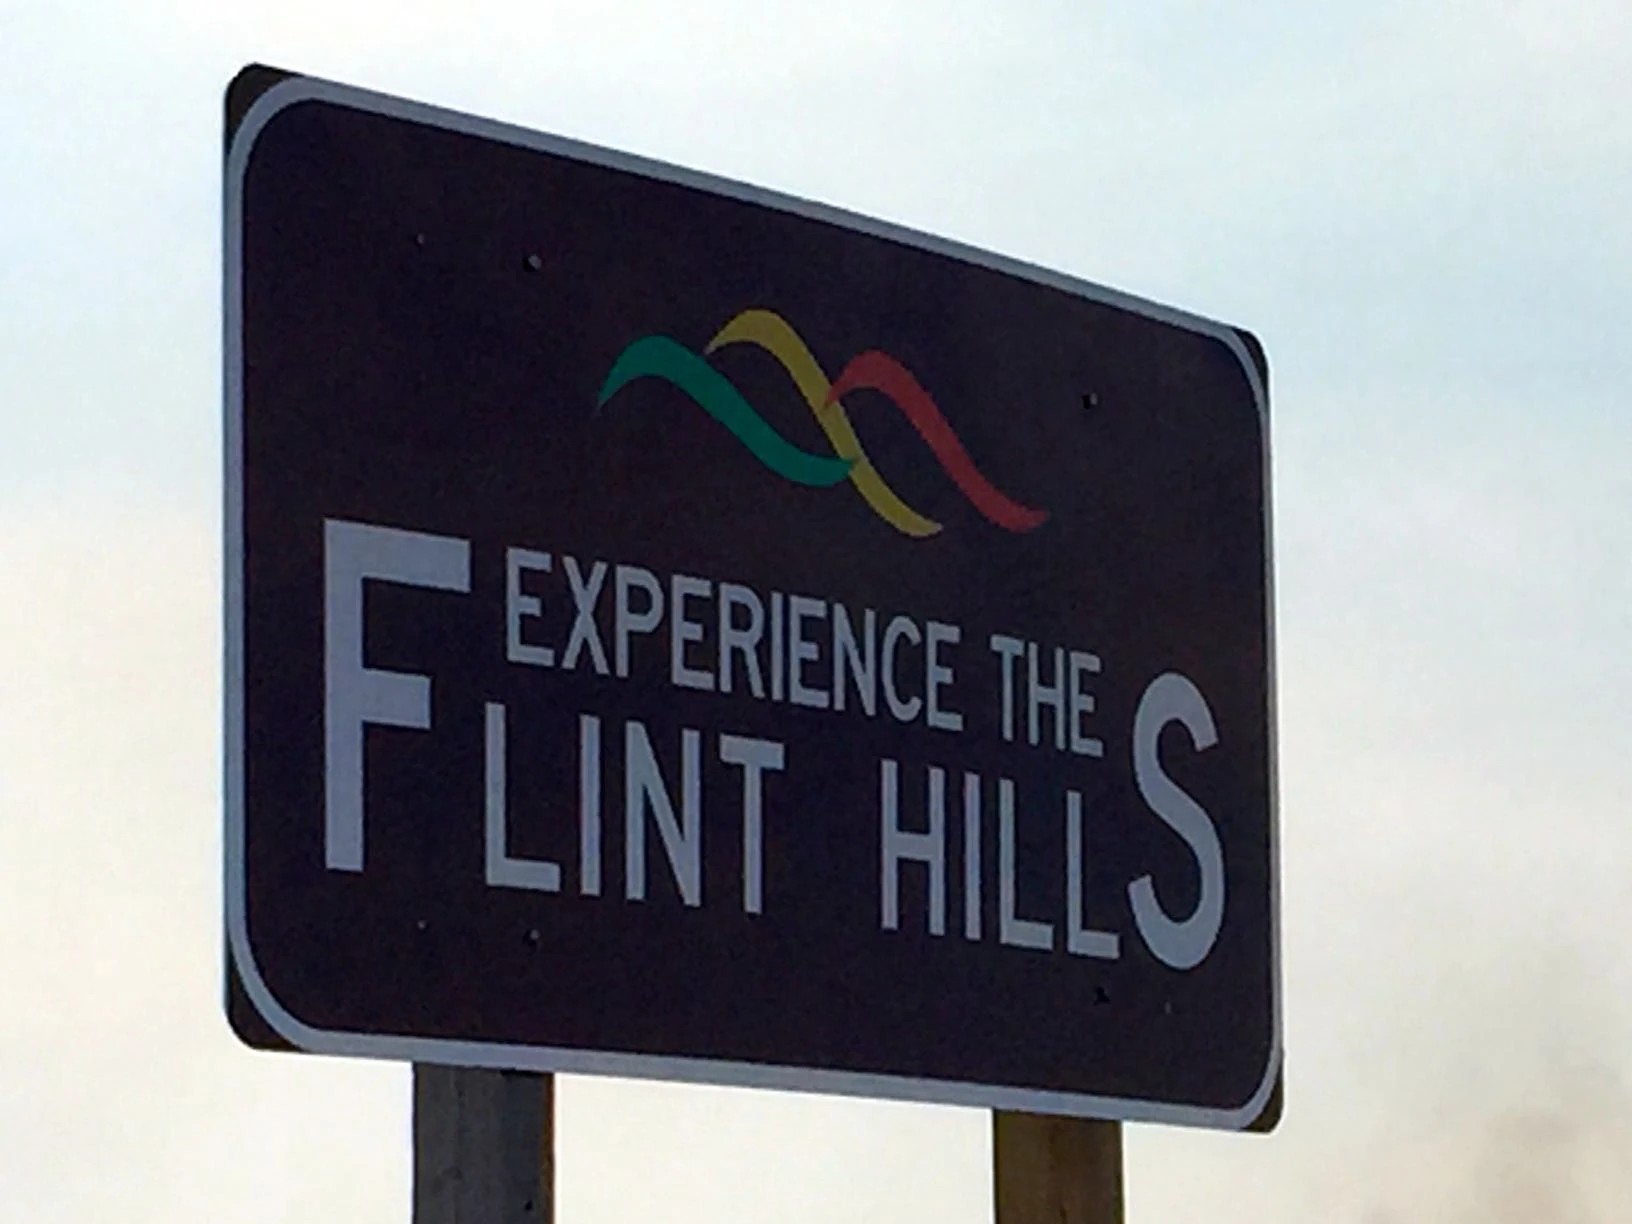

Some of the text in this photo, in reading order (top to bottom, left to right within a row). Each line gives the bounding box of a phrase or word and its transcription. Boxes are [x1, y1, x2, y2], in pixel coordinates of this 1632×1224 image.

[323, 518, 1226, 970] FLINT HILLS
[505, 546, 1104, 758] EXPERIENCE THE
